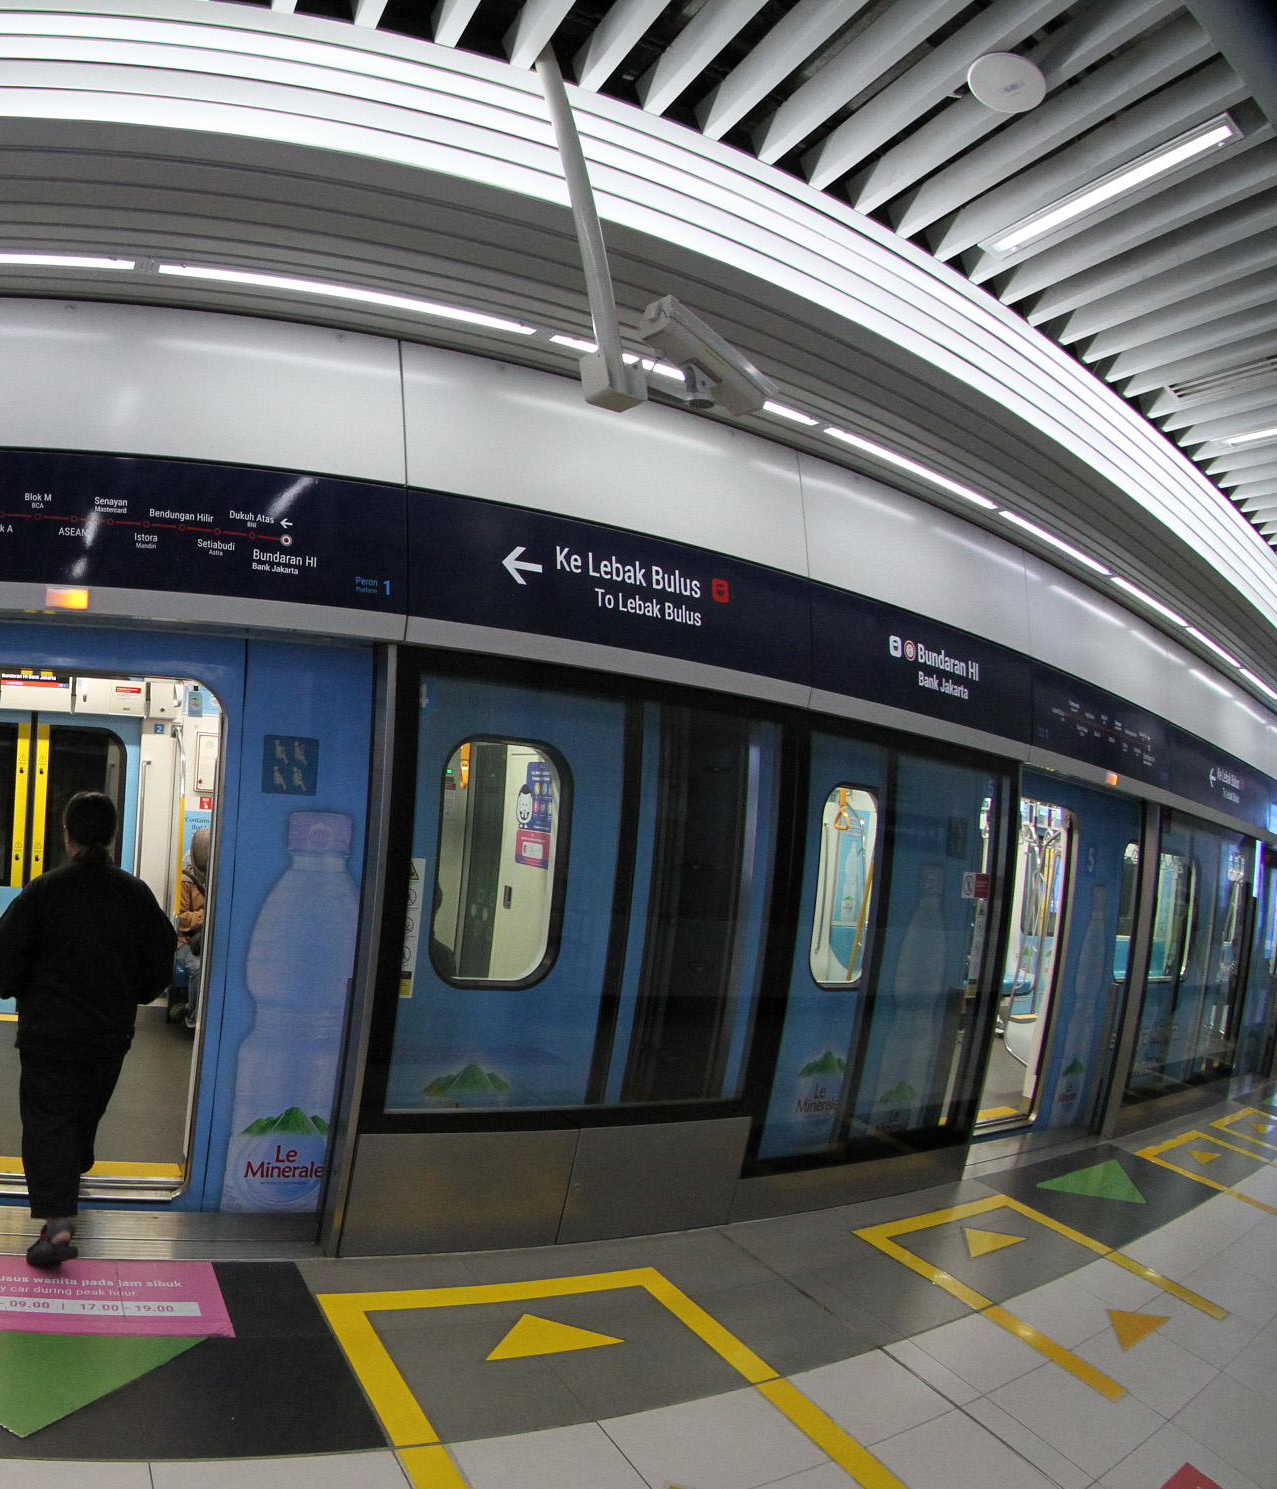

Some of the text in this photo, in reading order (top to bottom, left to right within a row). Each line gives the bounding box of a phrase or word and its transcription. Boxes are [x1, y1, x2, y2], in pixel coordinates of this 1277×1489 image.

[24, 492, 52, 502] Blok M
[94, 496, 128, 508] Senayan
[94, 506, 127, 514] Mastercard
[149, 508, 214, 523] Bendungan Hilir
[229, 510, 275, 524] Dukuh Atas
[4, 525, 13, 533] A
[58, 527, 87, 537] ASEAN
[134, 532, 158, 542] Istora
[197, 538, 236, 551] Setiabudi
[208, 549, 224, 557] Astra
[252, 549, 317, 568] Bundaran HI
[252, 562, 299, 575] Bank Jakarta
[555, 546, 701, 598] Ke Lebak Bulus
[355, 576, 391, 596] Peron 1
[594, 588, 702, 627] To Lebak Bulus
[917, 643, 979, 682] Bundaran HI
[918, 671, 969, 700] Bank Jakarta
[156, 725, 162, 733] 2
[813, 1083, 827, 1099] Le
[275, 1145, 298, 1163] Le
[244, 1160, 324, 1179] Minerale
[33, 1276, 77, 1285] wanita
[81, 1279, 114, 1287] pada
[117, 1279, 142, 1288] jam
[146, 1280, 184, 1288] sibuk
[10, 1284, 30, 1293] car
[33, 1286, 72, 1296] during
[76, 1288, 106, 1297] peak
[108, 1289, 137, 1297] hour
[9, 1300, 50, 1309] 09.00
[79, 1303, 119, 1311] 17.00
[135, 1304, 174, 1312] 19.00
